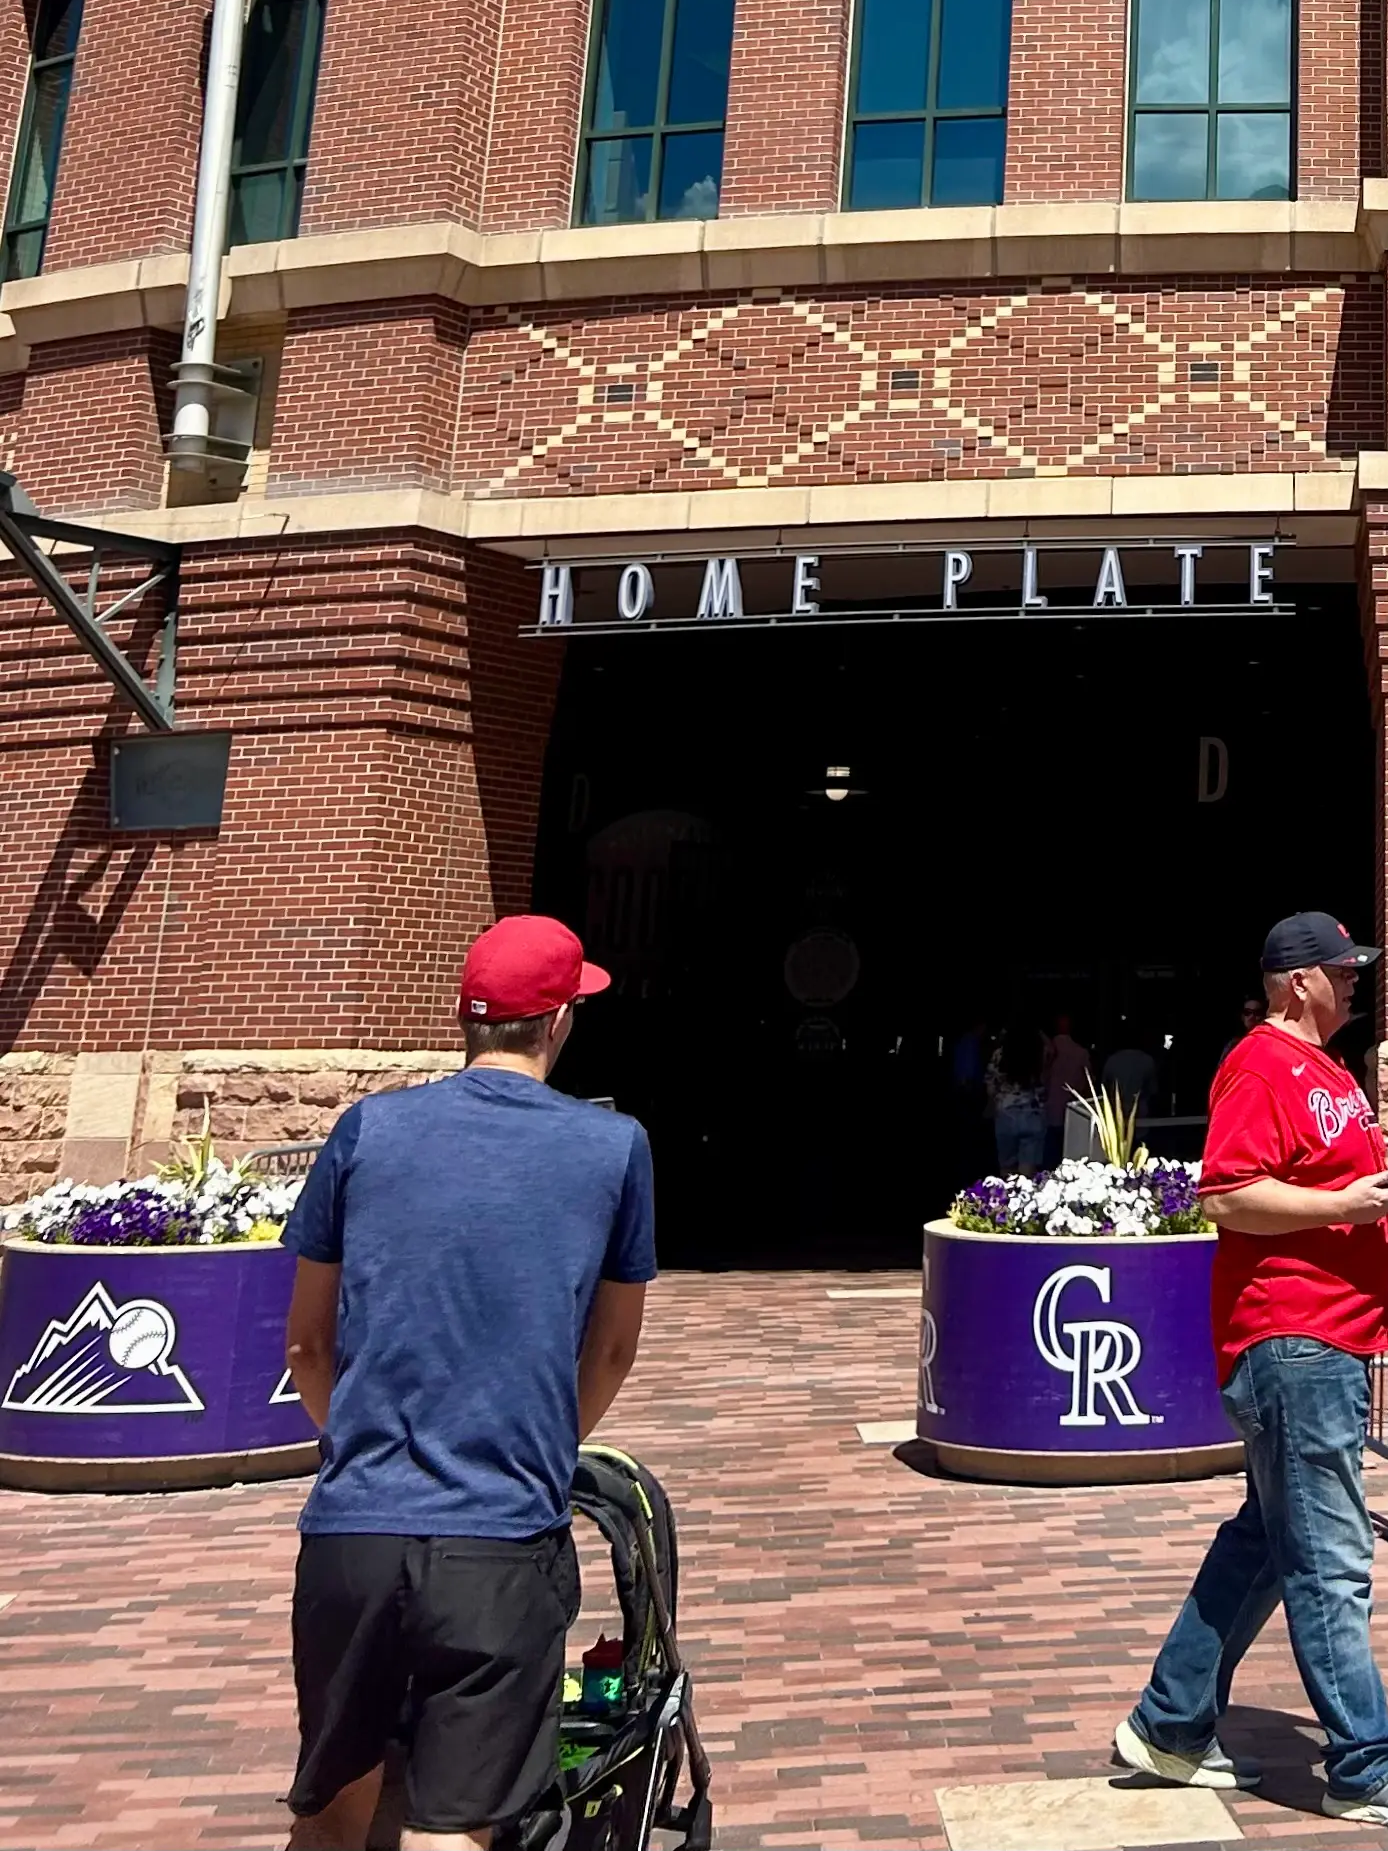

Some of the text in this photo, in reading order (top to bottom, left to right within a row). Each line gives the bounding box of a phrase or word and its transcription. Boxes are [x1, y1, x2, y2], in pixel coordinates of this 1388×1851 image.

[539, 544, 1276, 626] HOME PLATE
[1033, 1264, 1150, 1426] CR
